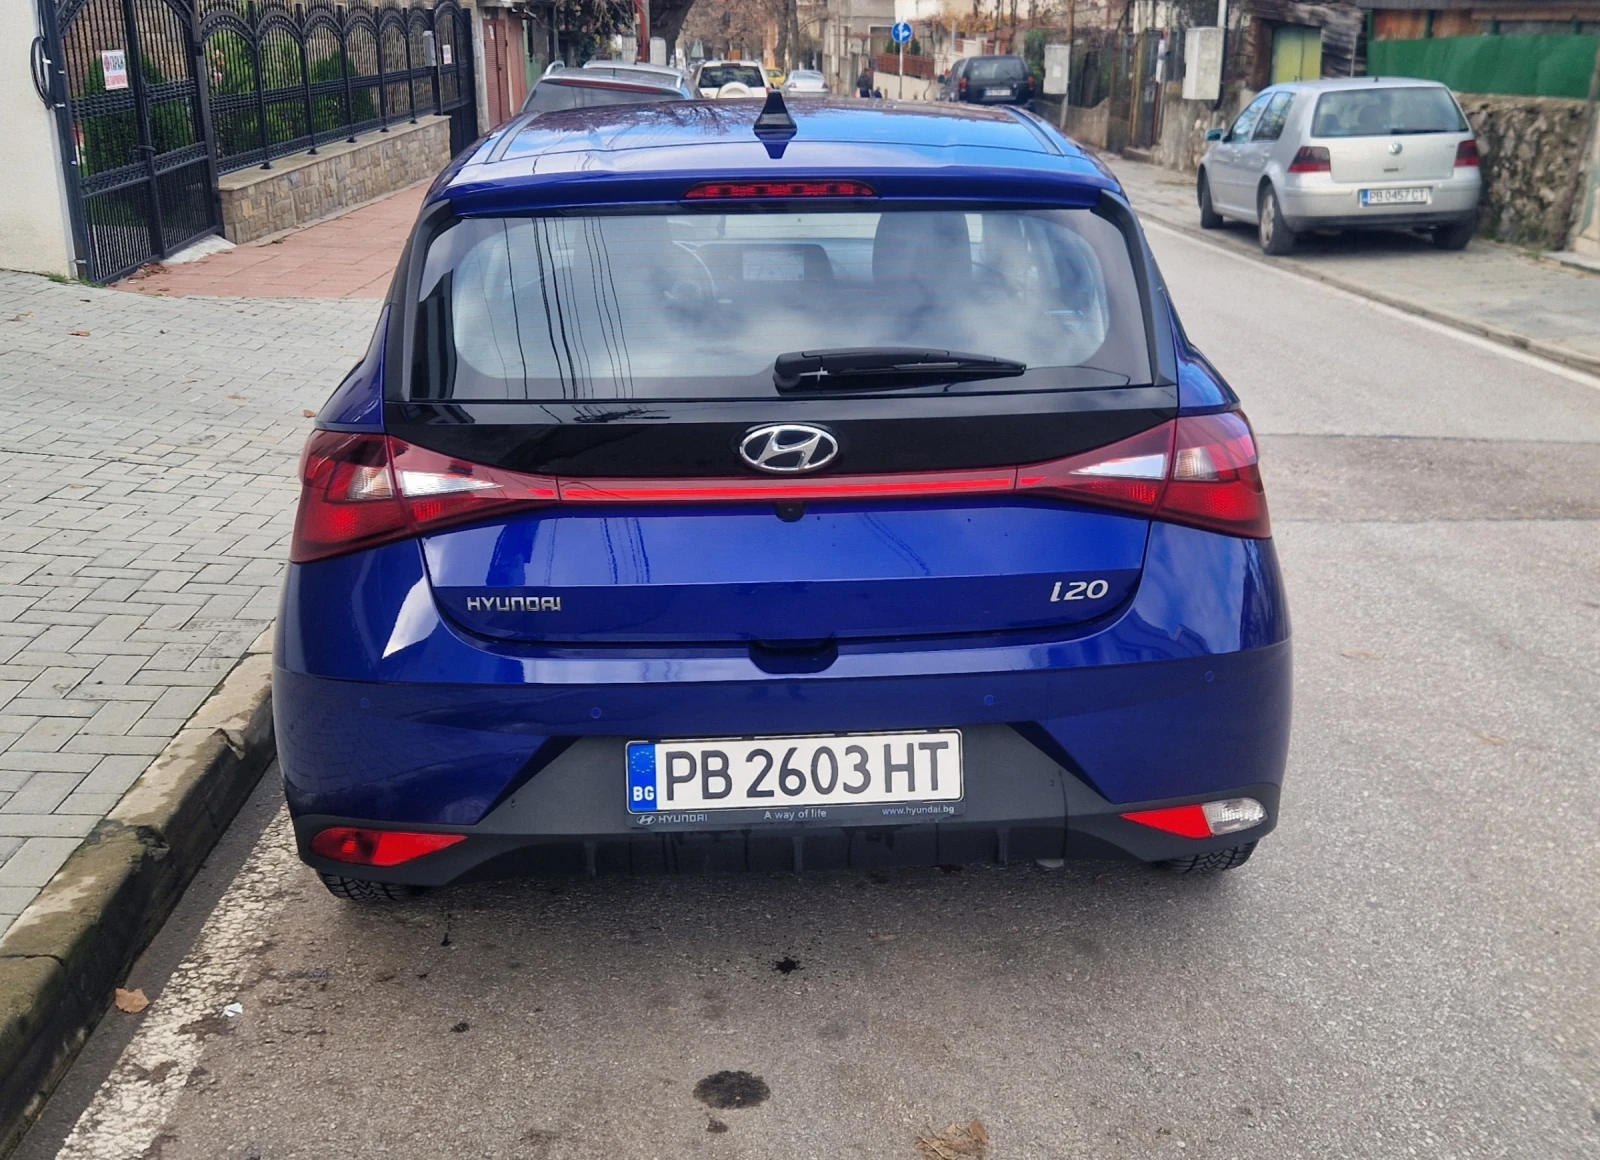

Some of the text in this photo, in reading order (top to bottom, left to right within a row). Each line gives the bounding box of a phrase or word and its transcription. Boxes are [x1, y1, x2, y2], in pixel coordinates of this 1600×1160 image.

[466, 596, 562, 612] HYUNDAI
[665, 741, 949, 801] PB 2603 HT
[632, 785, 655, 802] BG
[763, 808, 827, 821] A way of life
[882, 805, 955, 816] www.hyundai.bg
[658, 813, 708, 824] HYUNDAI
